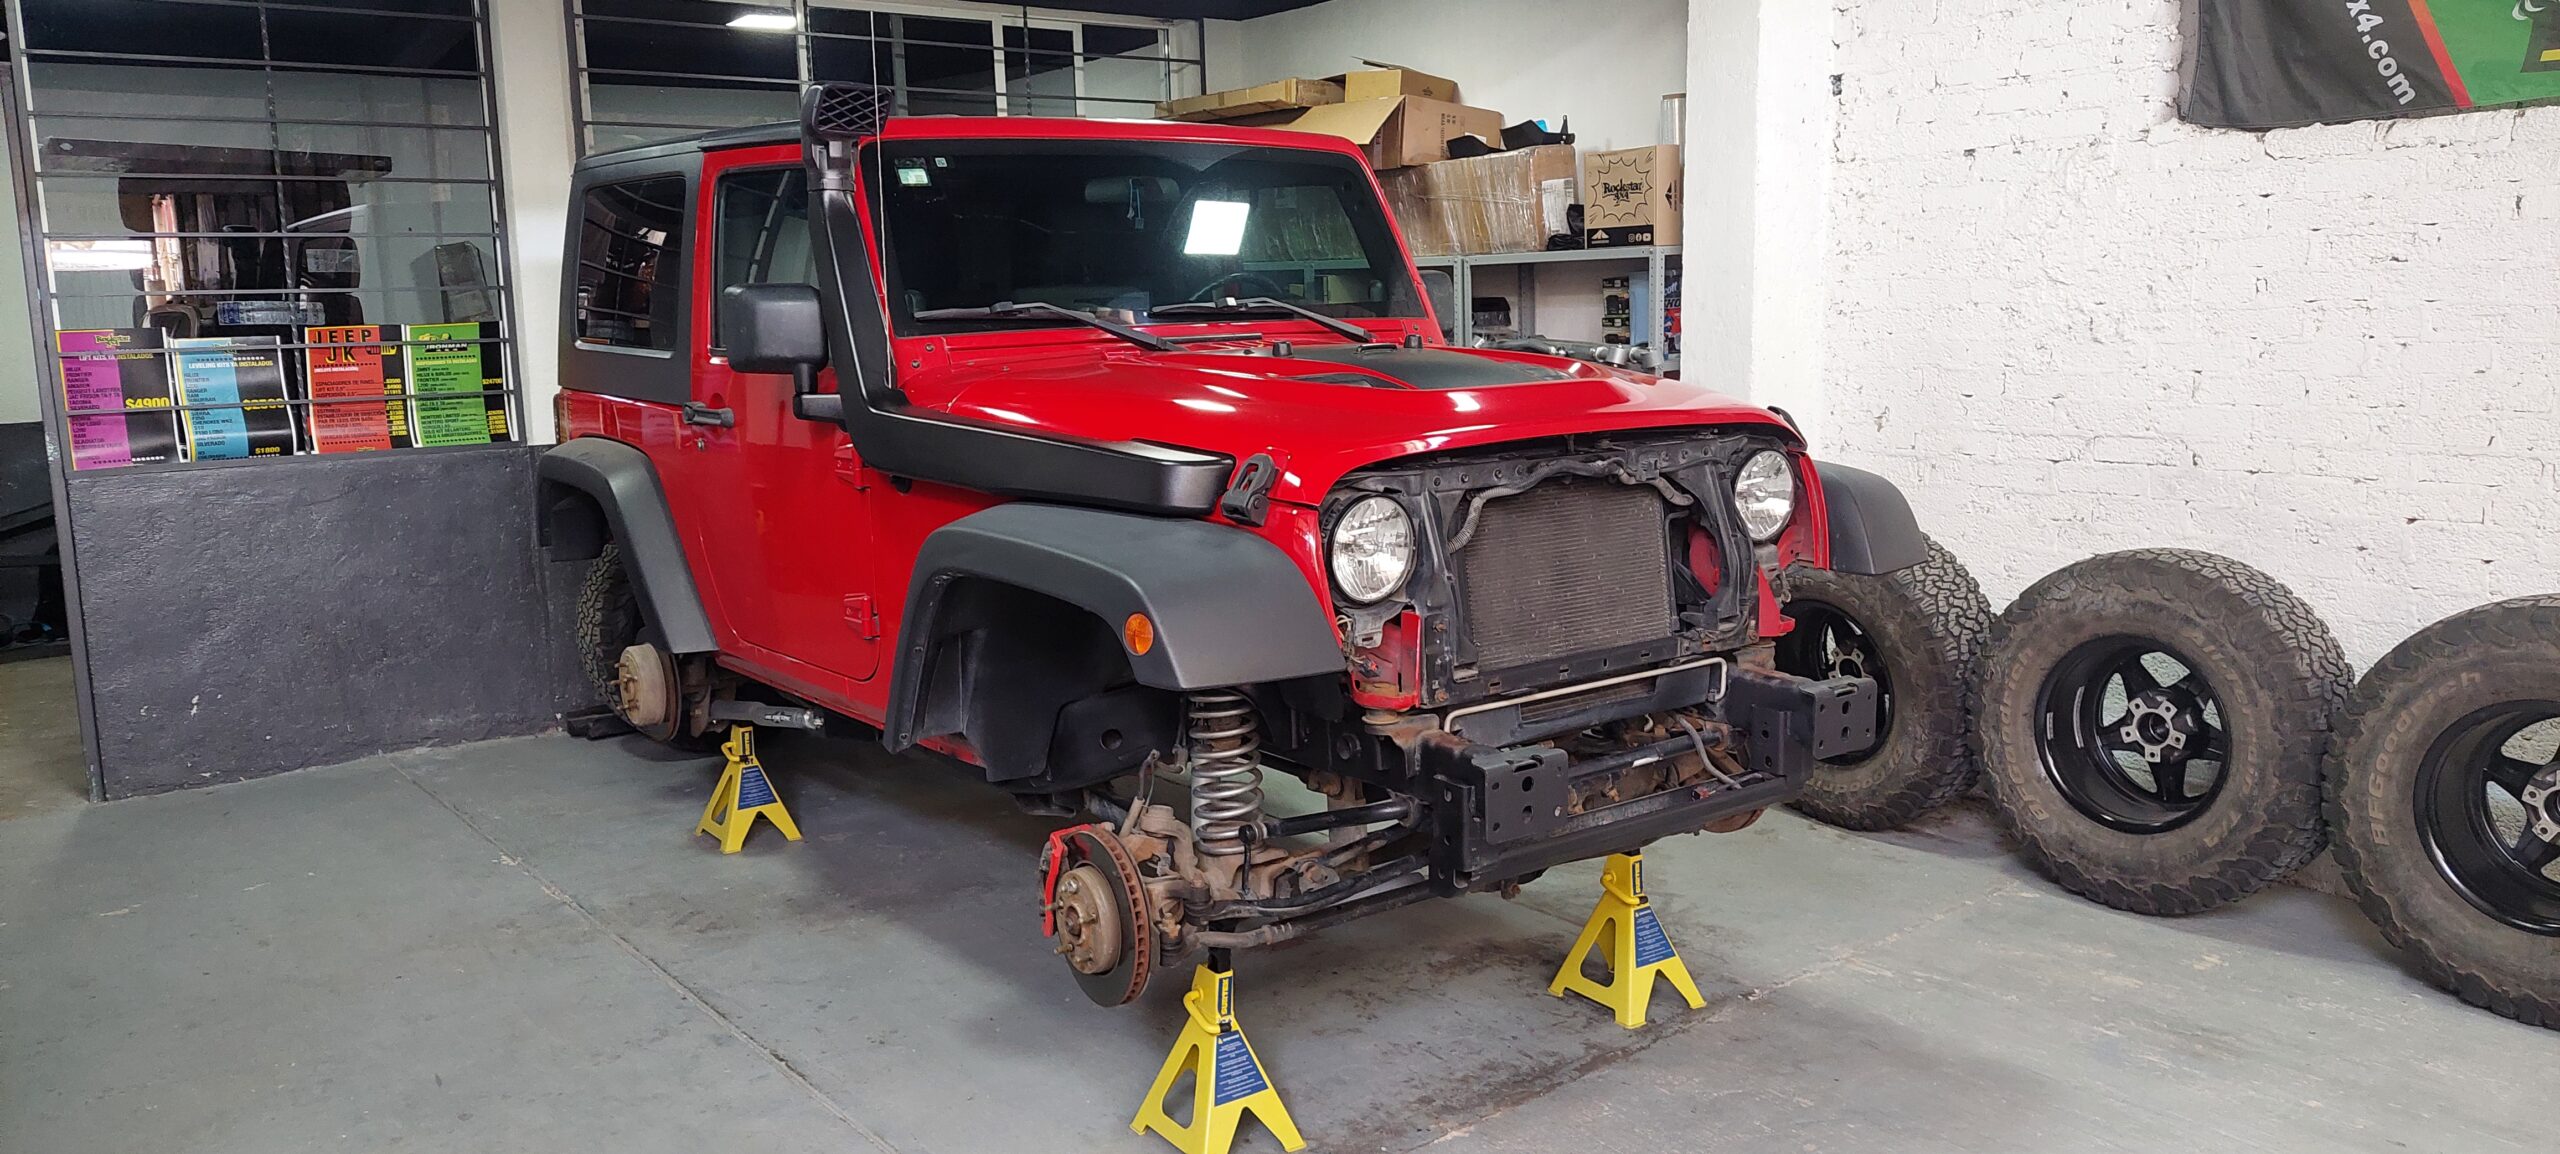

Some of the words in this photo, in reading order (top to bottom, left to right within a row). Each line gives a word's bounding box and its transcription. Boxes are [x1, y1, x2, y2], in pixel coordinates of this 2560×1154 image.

[1602, 178, 1643, 194] Rockstar
[313, 329, 372, 344] JEEP
[116, 351, 154, 360] INSTALADOS
[125, 396, 170, 409] $4900
[2368, 672, 2481, 846] BFGoodrich
